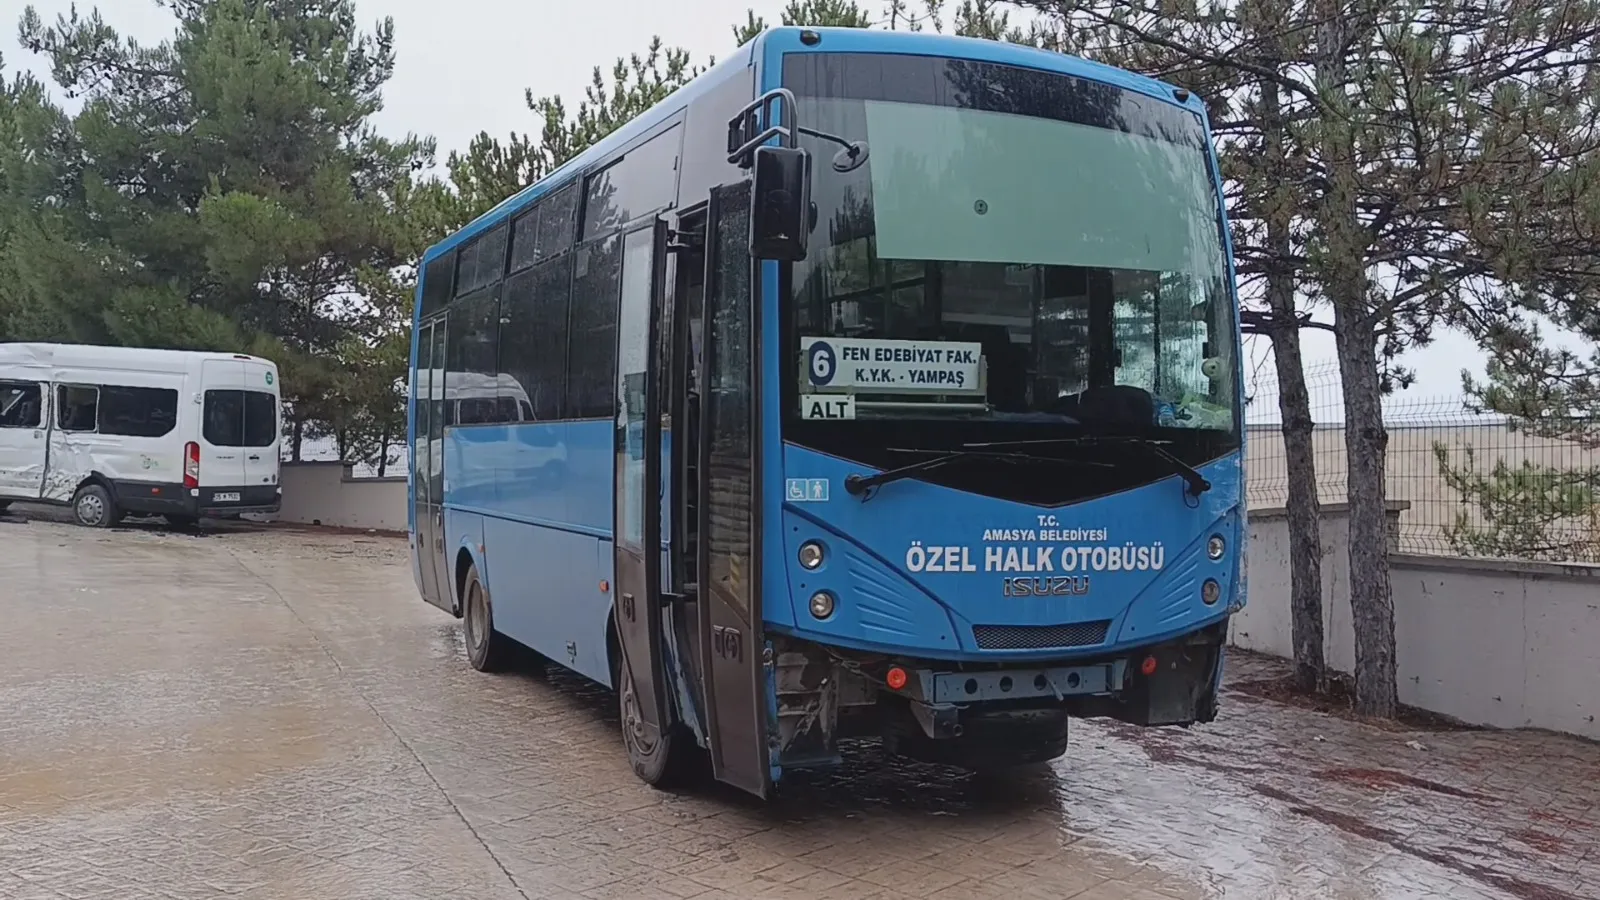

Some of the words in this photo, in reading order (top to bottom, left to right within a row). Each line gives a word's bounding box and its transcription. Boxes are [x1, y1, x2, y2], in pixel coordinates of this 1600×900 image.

[813, 350, 830, 377] 6
[842, 347, 870, 361] FEN
[874, 345, 942, 363] EDEBİYAT
[946, 350, 977, 364] FAK.
[855, 368, 895, 383] K.Y.K.
[908, 369, 964, 387] YAMPAŞ
[809, 402, 848, 419] ALT
[1037, 515, 1060, 527] T.C.
[983, 529, 1036, 541] AMASYA
[1040, 527, 1107, 541] BELEDİYESİ
[906, 541, 976, 572] ÖZEL
[985, 547, 1054, 572] HALK
[1061, 542, 1164, 571] OTOBÜSÜ
[1003, 576, 1089, 597] ISUZU
